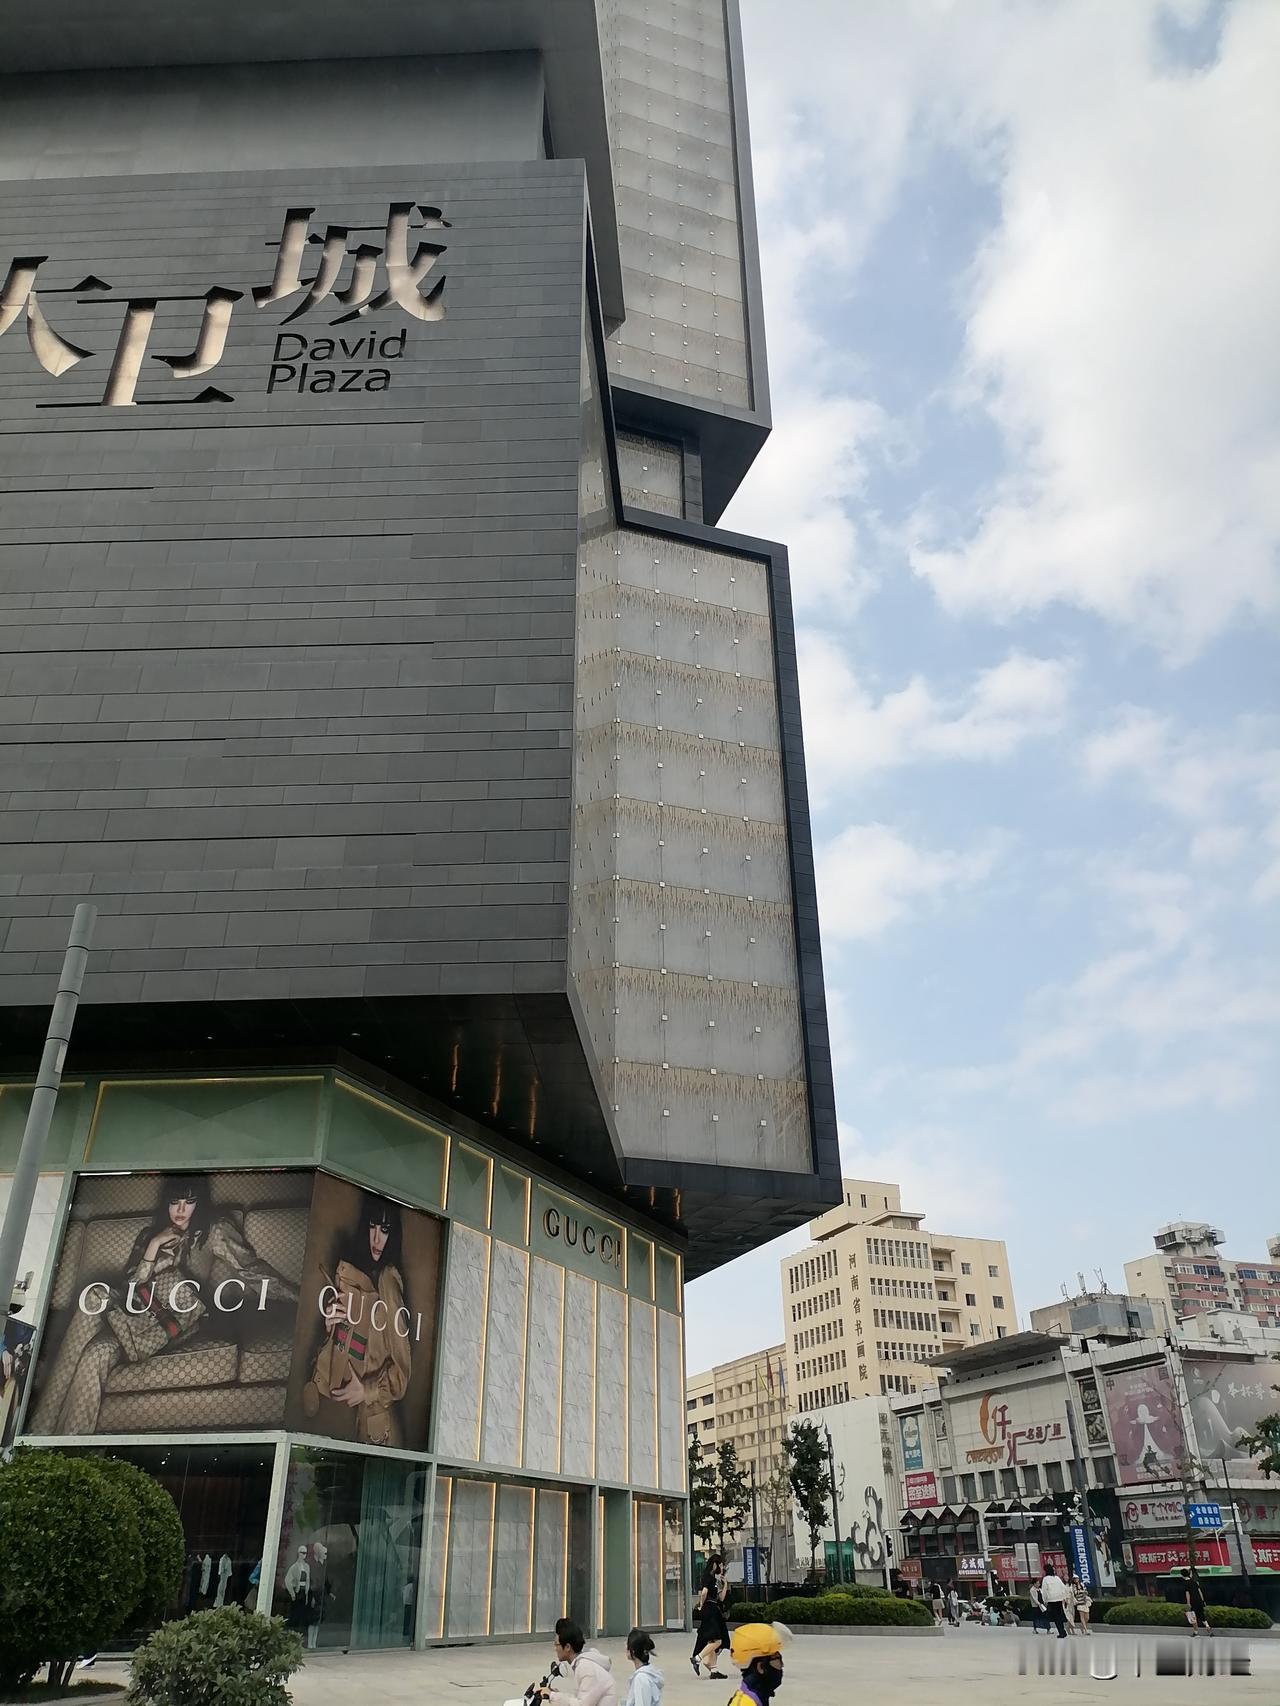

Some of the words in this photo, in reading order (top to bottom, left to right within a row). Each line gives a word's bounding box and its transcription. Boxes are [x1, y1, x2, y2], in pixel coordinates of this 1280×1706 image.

[272, 328, 407, 362] David
[266, 362, 392, 395] Plaza
[542, 1207, 622, 1270] GUCCI
[78, 1278, 271, 1315] GUCCI
[317, 1284, 424, 1342] GUCCI
[847, 1252, 869, 1381] 河南省书画院
[1074, 1528, 1091, 1585] BIRKENSTOCK
